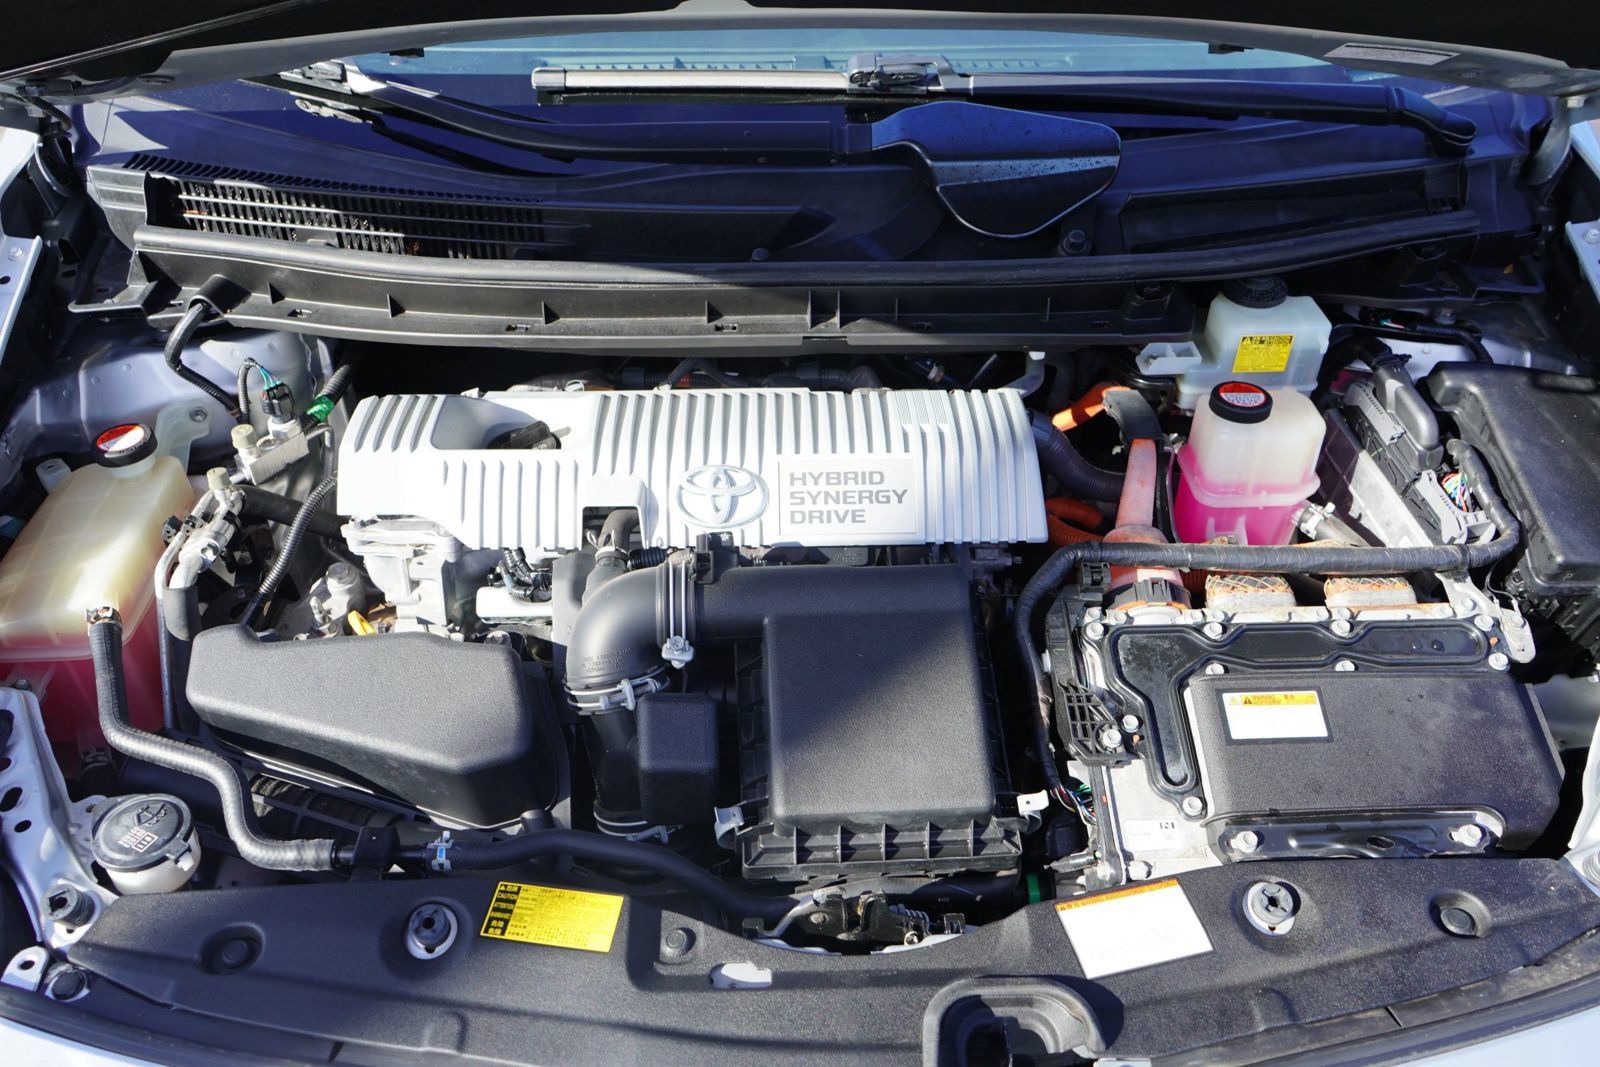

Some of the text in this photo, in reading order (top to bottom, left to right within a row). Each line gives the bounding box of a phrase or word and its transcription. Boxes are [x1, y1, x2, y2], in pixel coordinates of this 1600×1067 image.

[790, 471, 885, 486] HYBRID
[789, 489, 908, 505] SYNERGY
[790, 509, 866, 524] DRIVE
